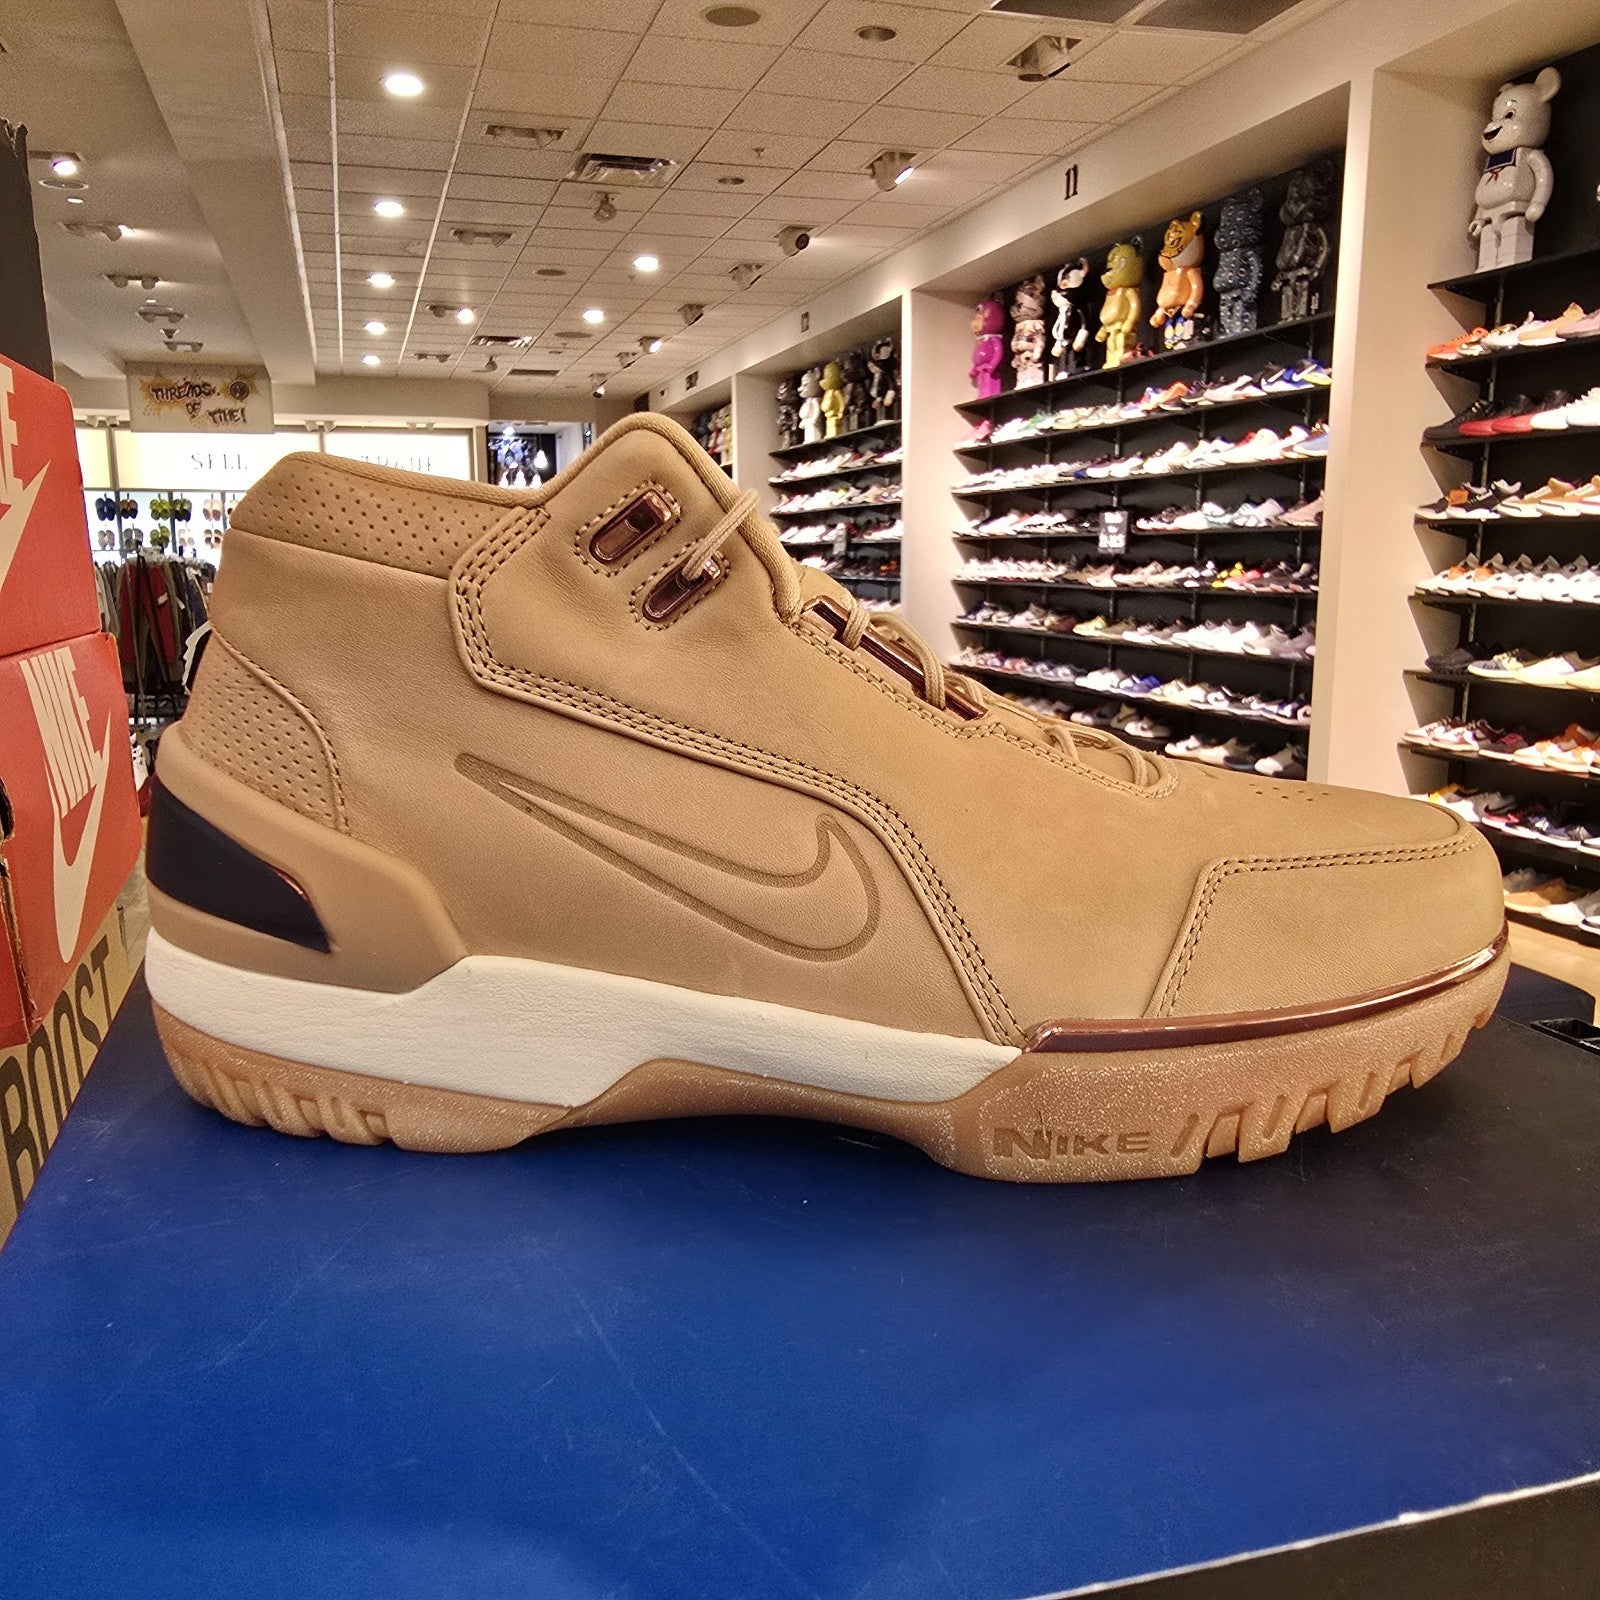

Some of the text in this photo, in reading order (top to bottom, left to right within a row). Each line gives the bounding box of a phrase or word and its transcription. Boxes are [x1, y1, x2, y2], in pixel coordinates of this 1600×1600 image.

[191, 453, 249, 470] SELL
[19, 646, 102, 819] NIKE
[993, 1127, 1150, 1160] NIKE
